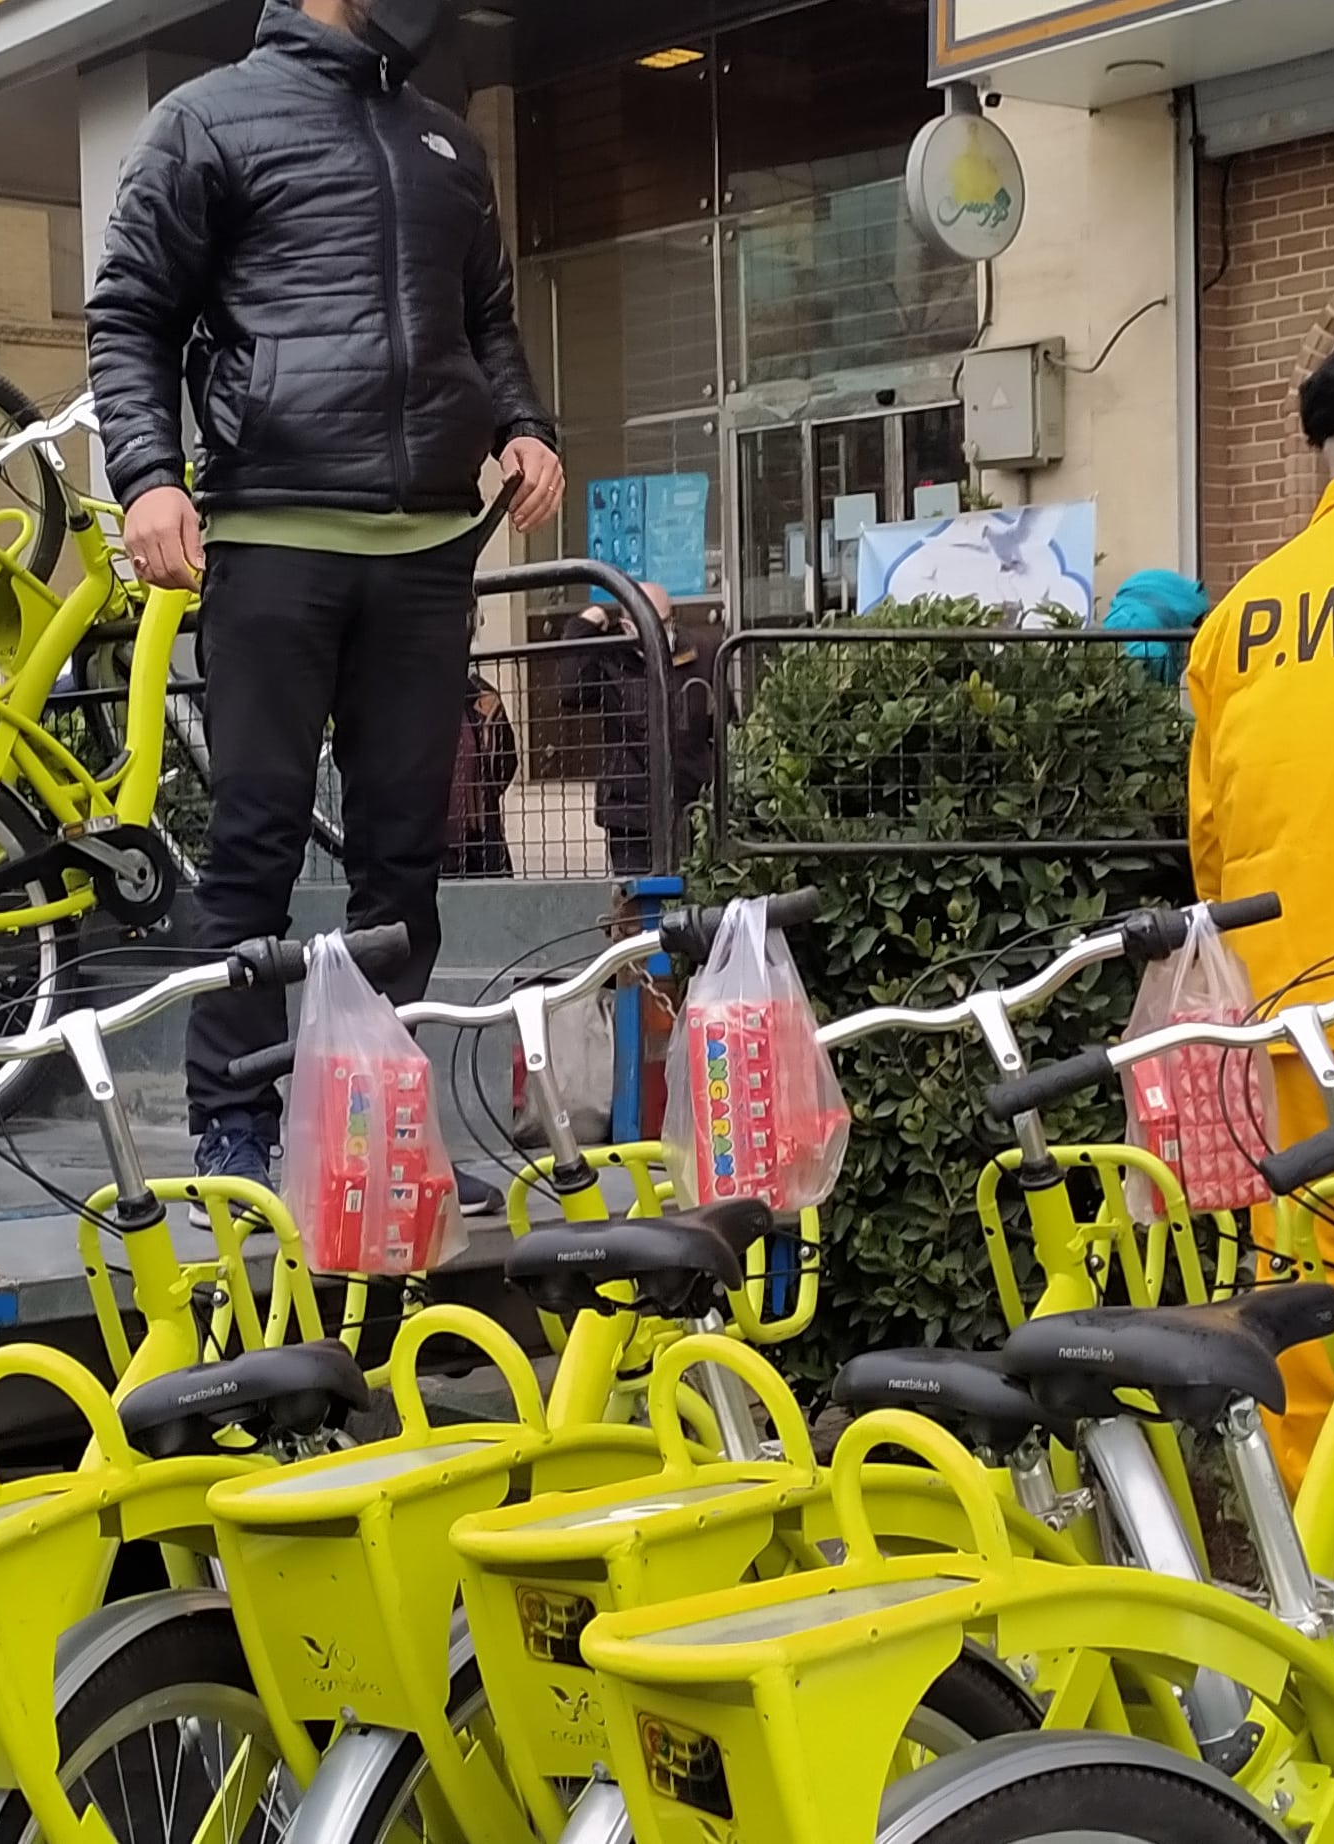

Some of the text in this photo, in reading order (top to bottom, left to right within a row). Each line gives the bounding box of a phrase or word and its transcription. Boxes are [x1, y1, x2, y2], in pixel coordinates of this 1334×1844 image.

[1059, 1345, 1101, 1360] nextbike
[888, 1377, 928, 1391] nextbike
[178, 1386, 223, 1405] nextbike
